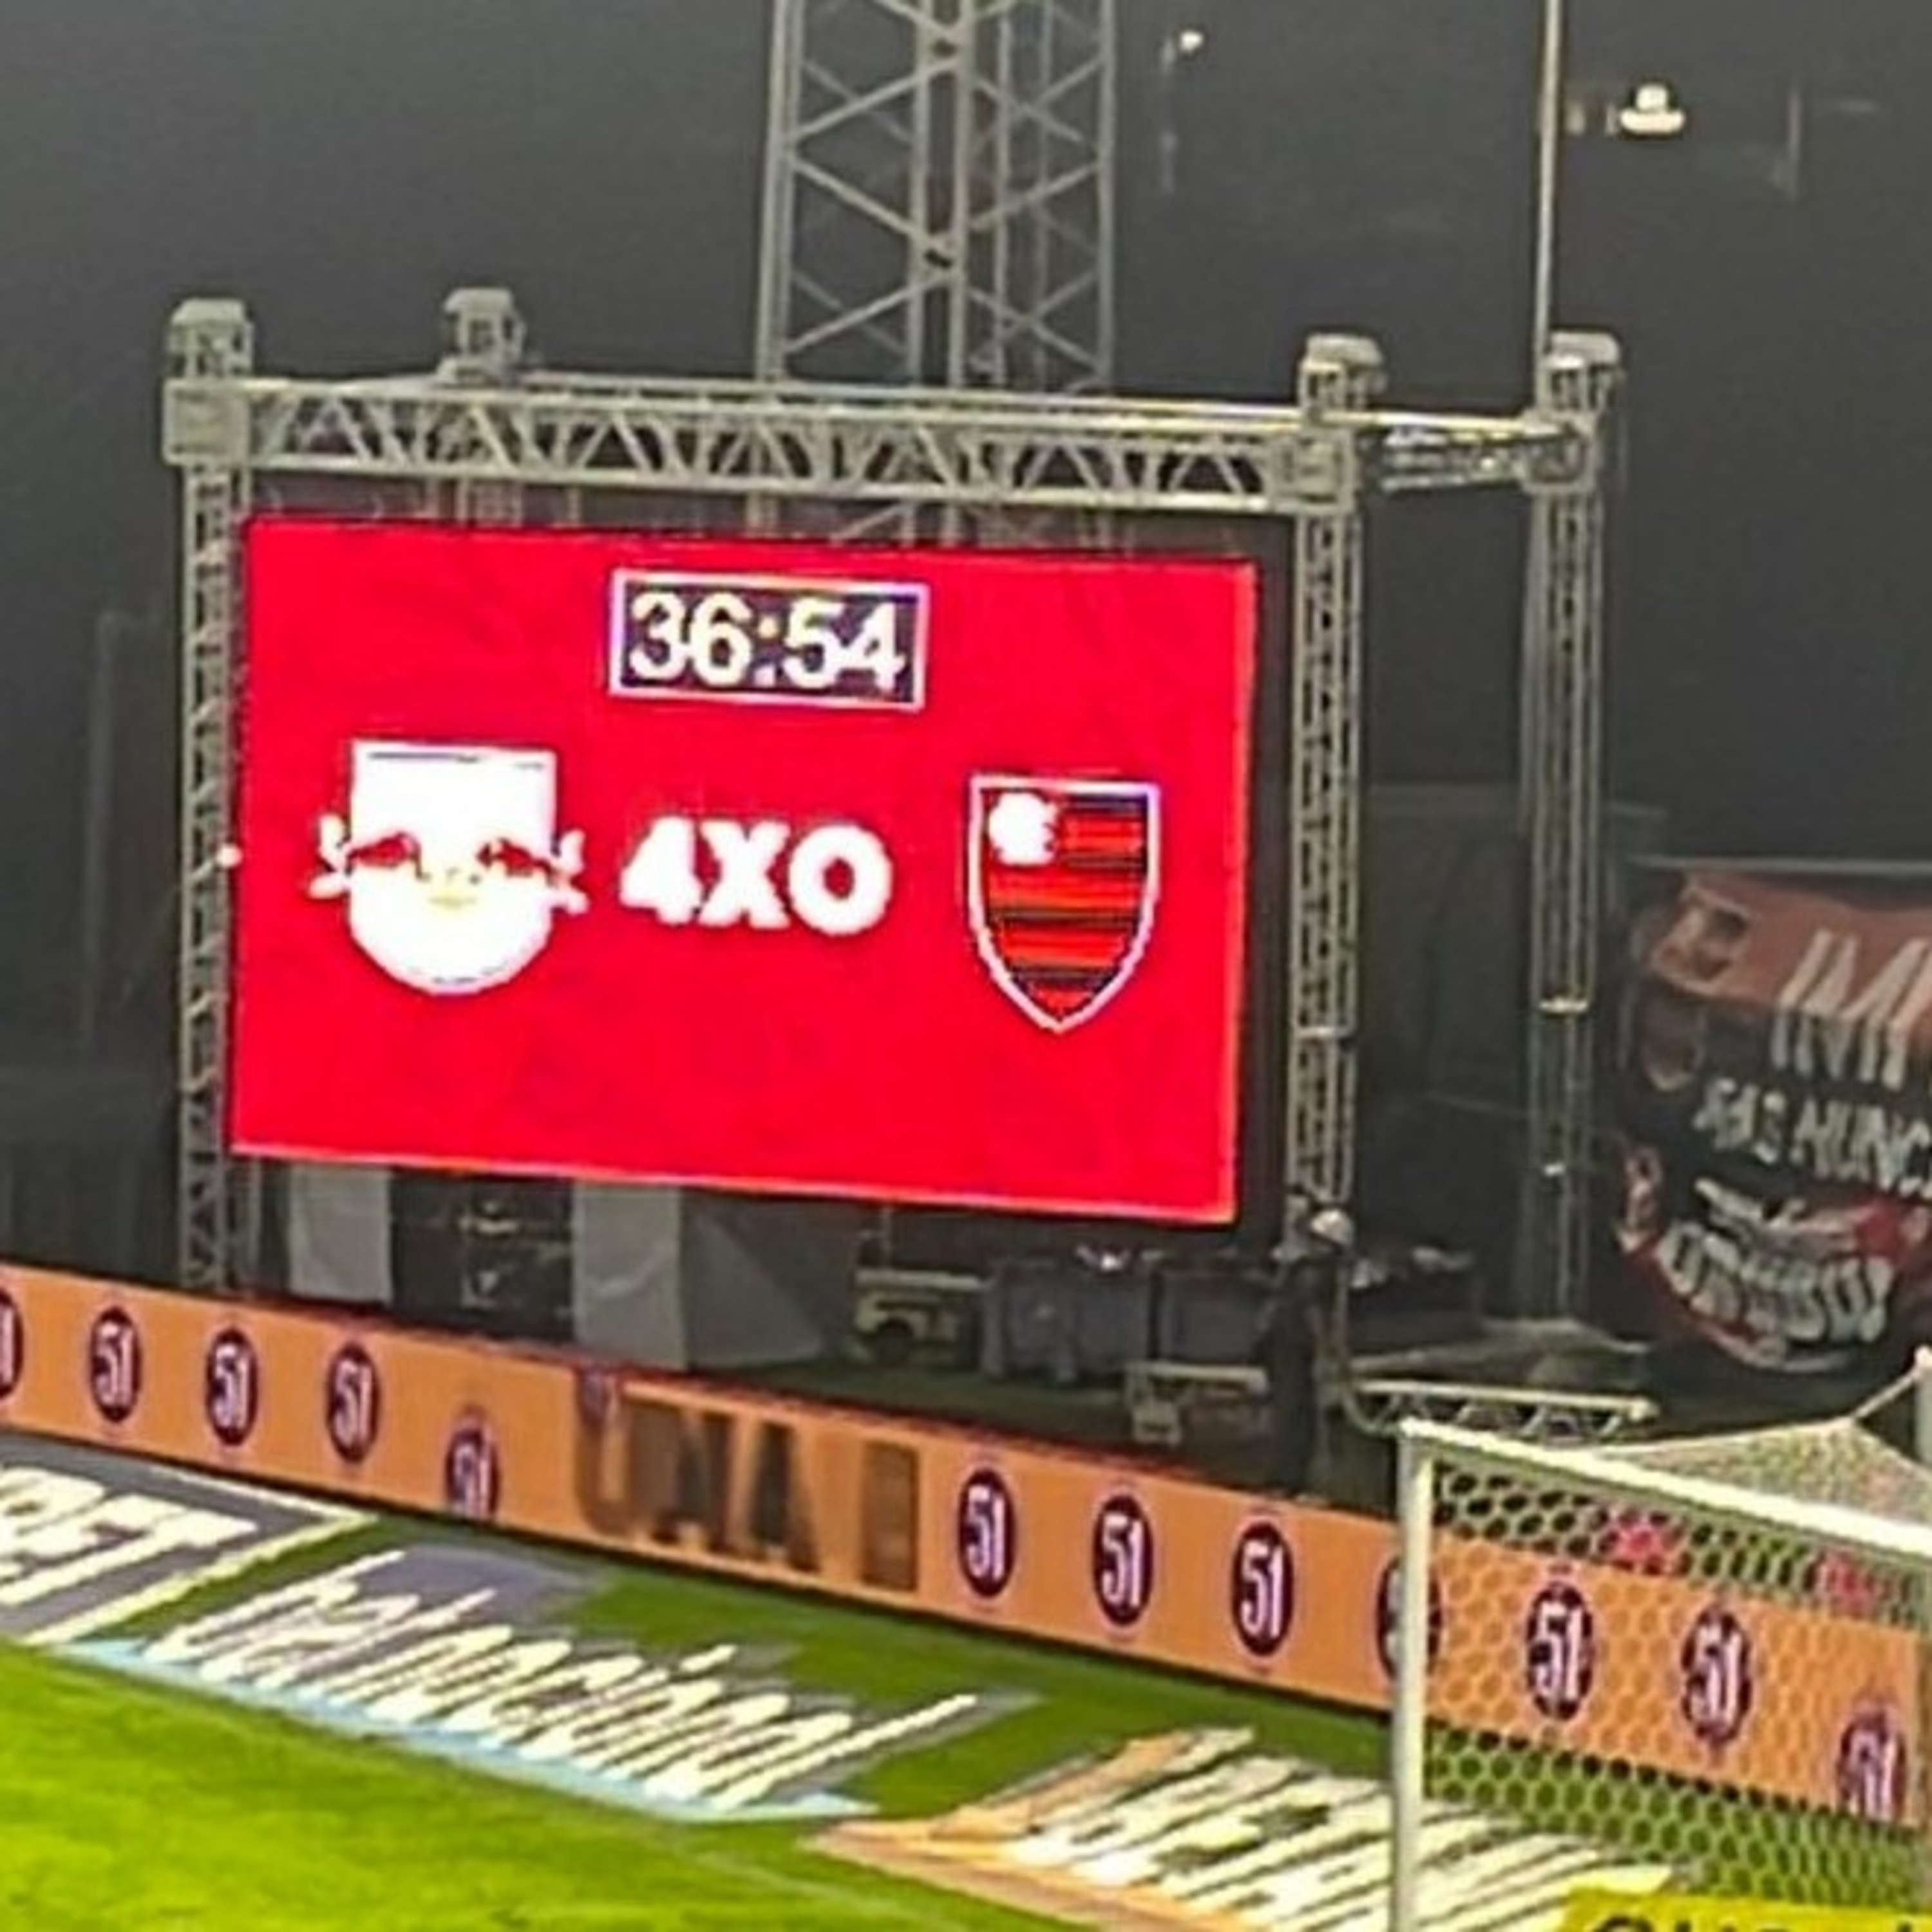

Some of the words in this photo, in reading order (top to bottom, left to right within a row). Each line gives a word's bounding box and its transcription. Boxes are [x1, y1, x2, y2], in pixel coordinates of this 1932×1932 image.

[629, 590, 905, 690] 36:54
[964, 1484, 1005, 1579] 51
[1100, 1513, 1142, 1613] 51
[1239, 1541, 1283, 1640] 51
